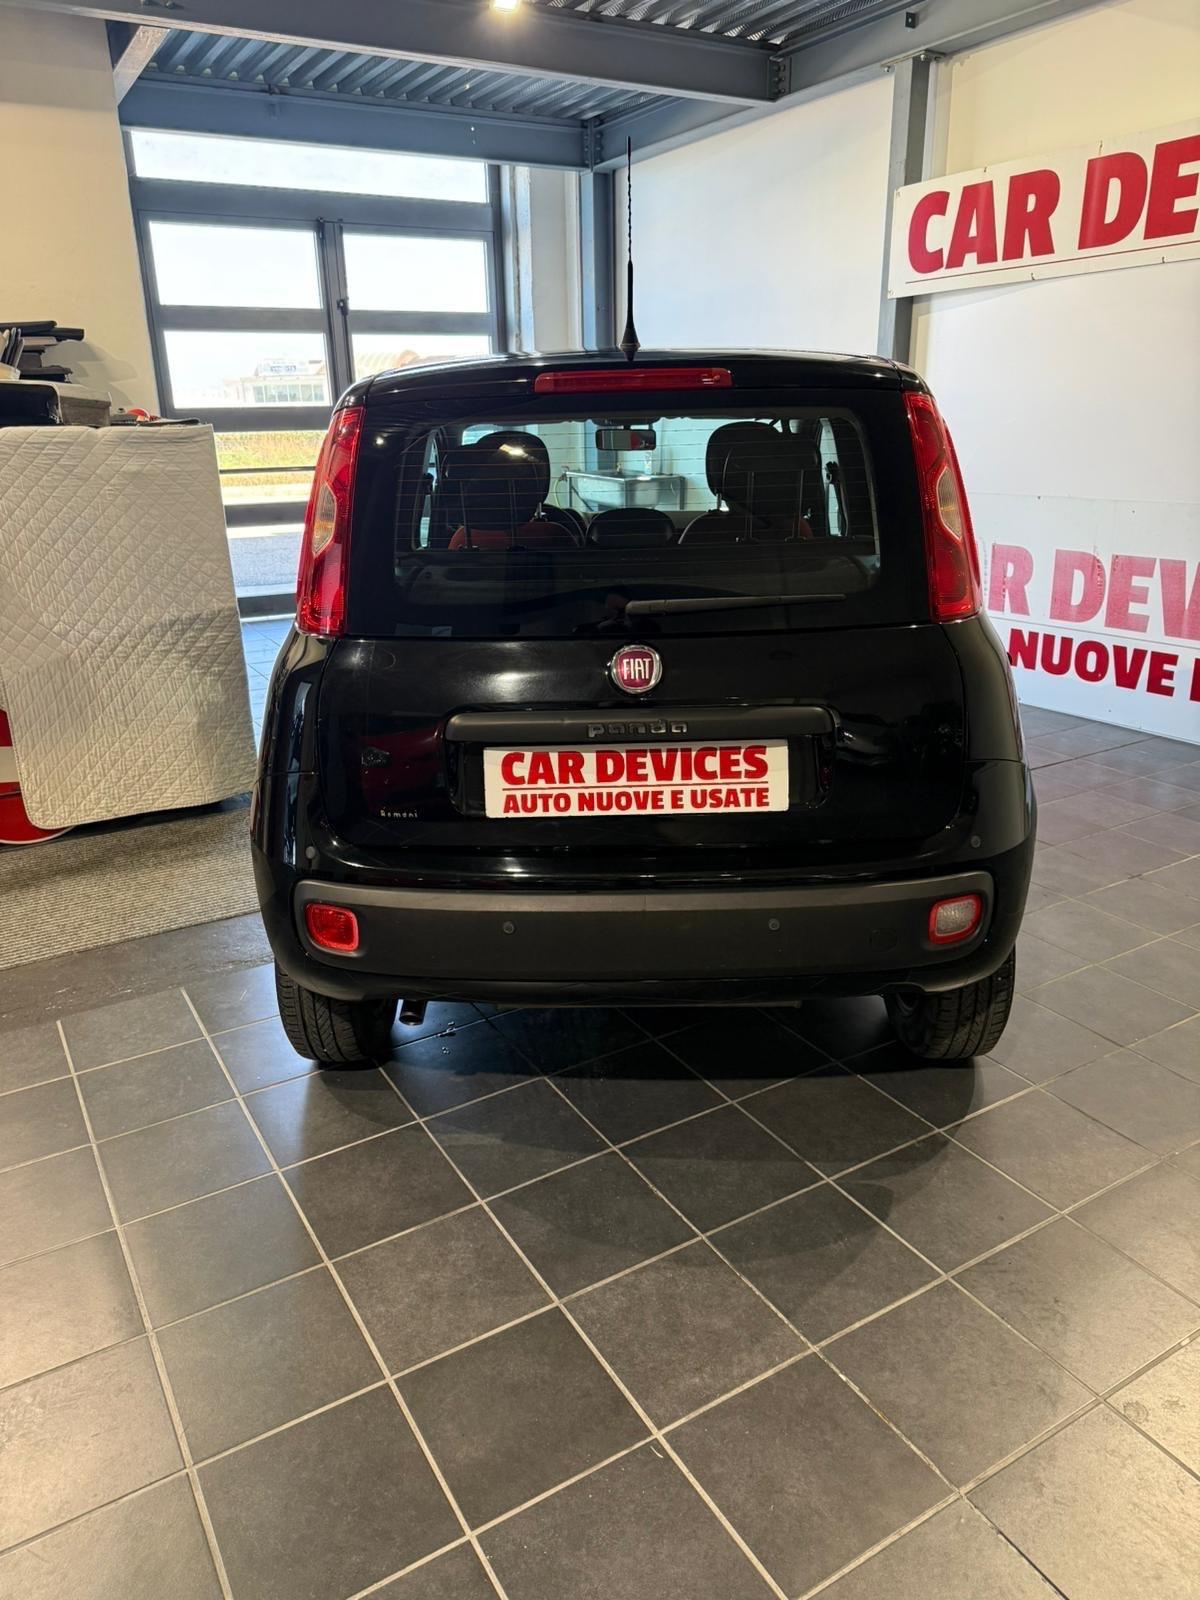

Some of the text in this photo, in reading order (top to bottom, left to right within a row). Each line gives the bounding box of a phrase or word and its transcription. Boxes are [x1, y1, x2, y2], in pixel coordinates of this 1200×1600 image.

[908, 169, 1061, 274] CAR
[622, 658, 652, 680] FIAT
[1008, 628, 1179, 698] NUOVE
[501, 745, 769, 785] CAR DEVICES
[503, 787, 770, 813] AUTO NUOVE E USATE
